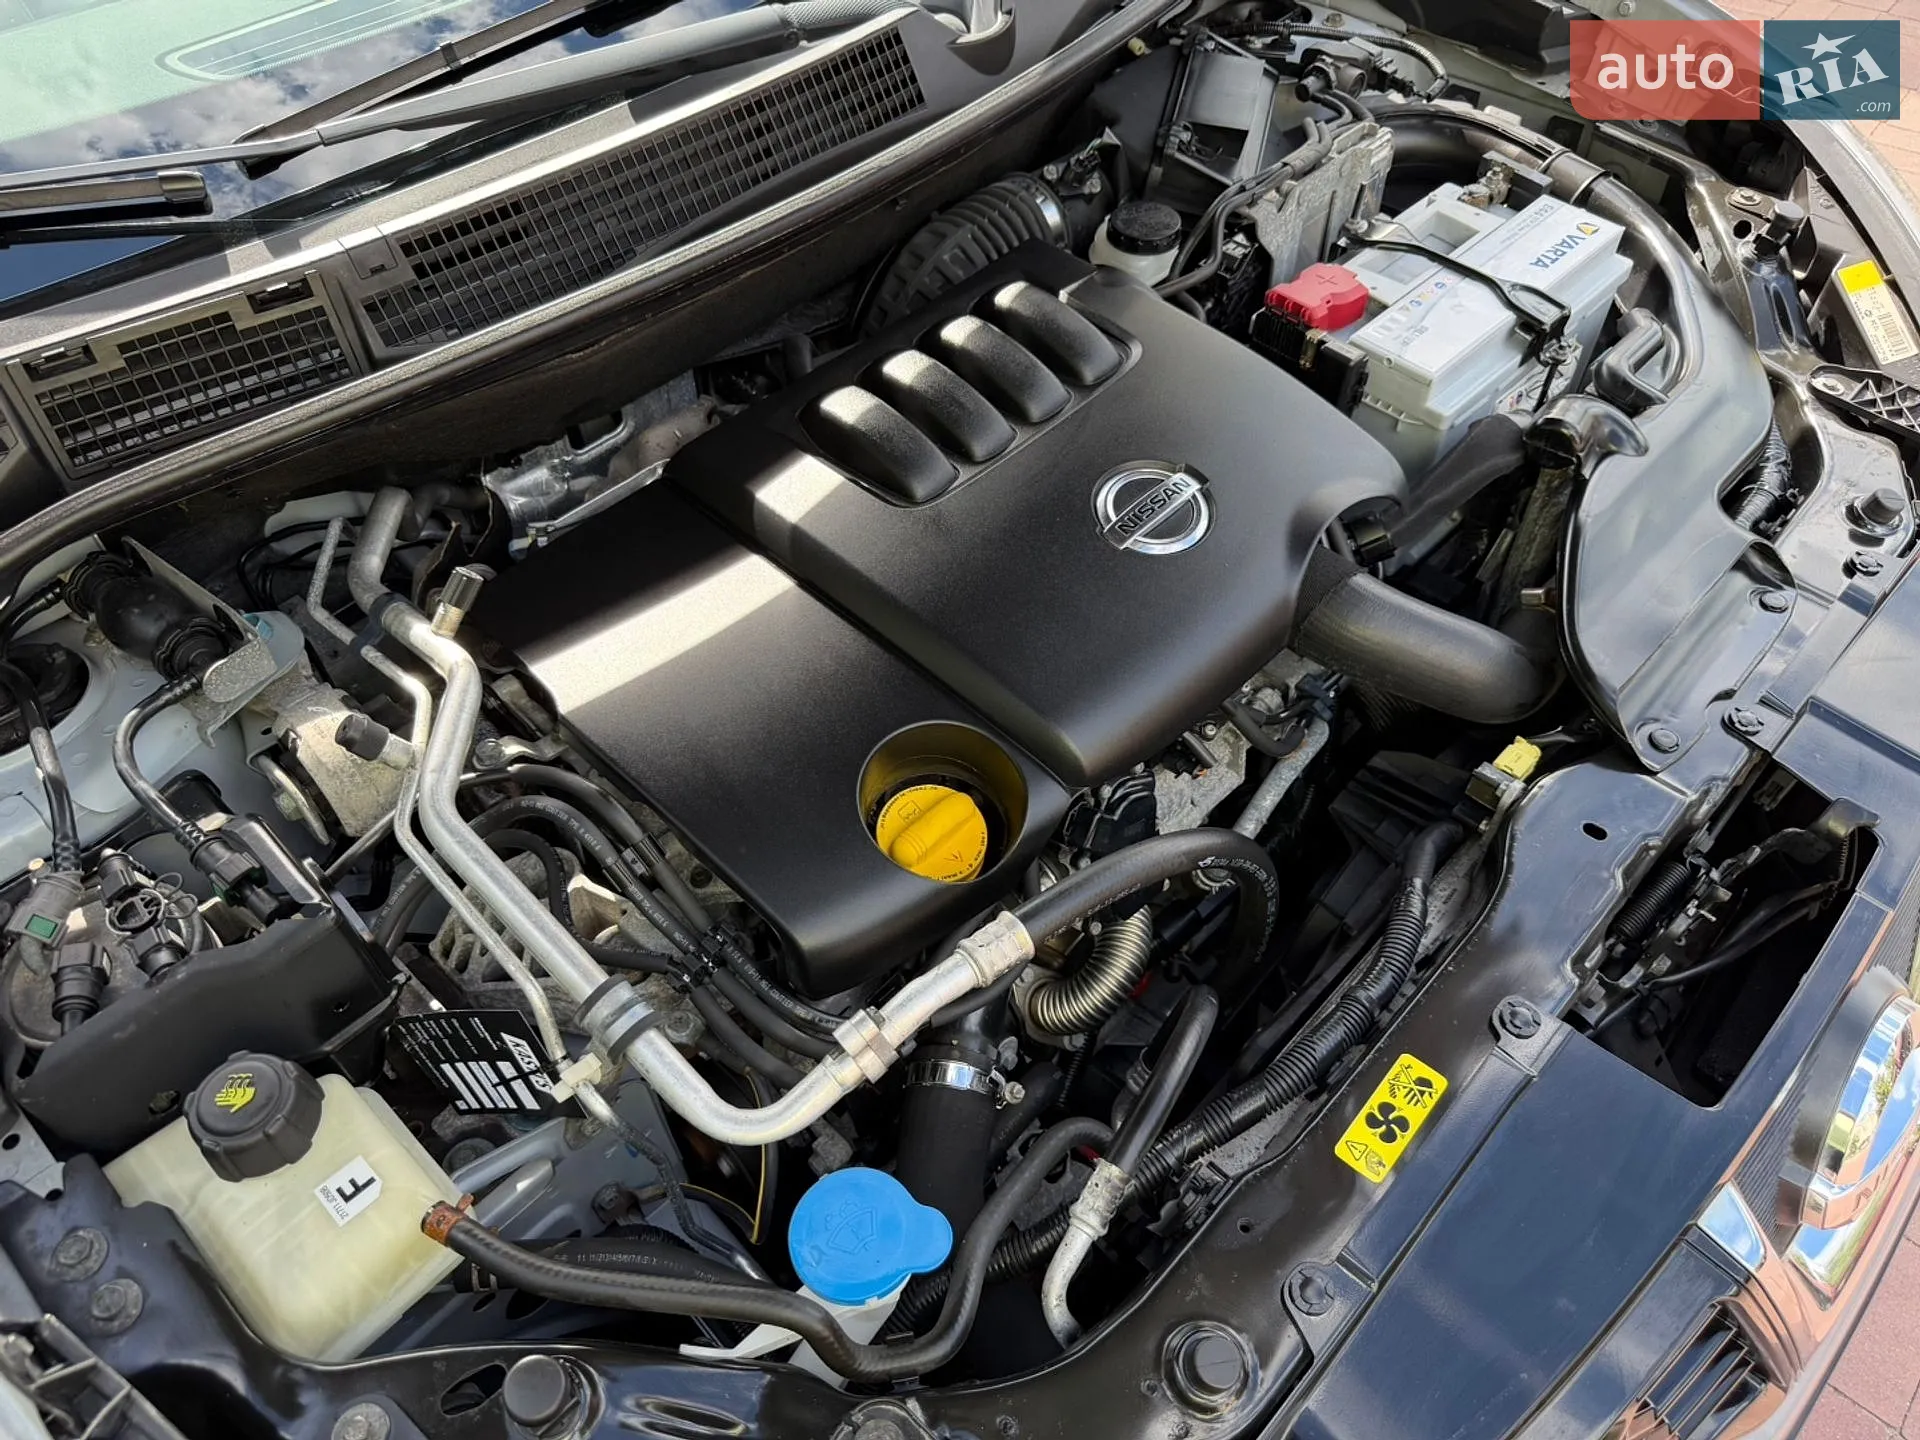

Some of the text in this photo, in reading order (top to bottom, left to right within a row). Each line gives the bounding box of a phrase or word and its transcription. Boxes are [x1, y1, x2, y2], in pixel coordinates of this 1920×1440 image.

[1529, 234, 1586, 269] VARTA
[1117, 478, 1191, 535] NISSAN
[336, 1176, 377, 1204] F
